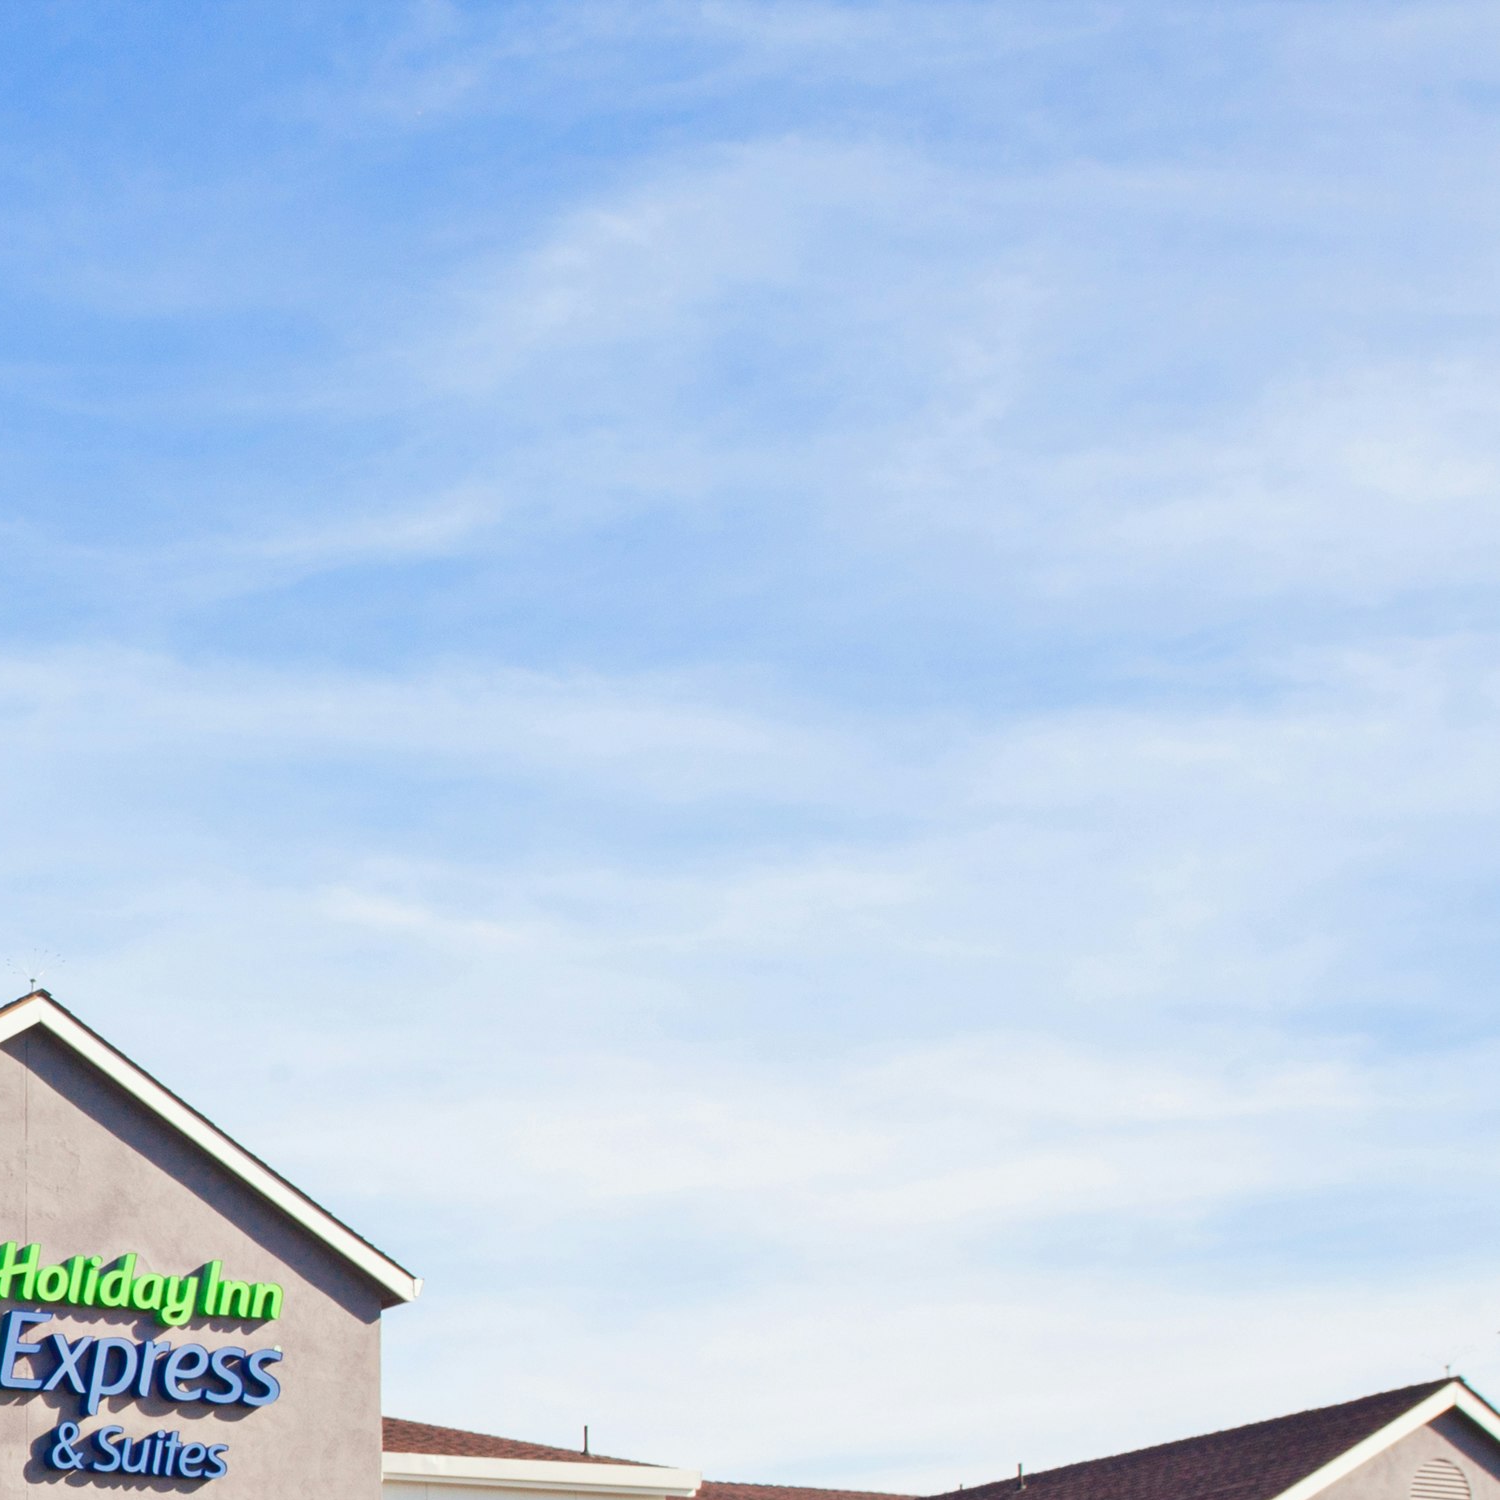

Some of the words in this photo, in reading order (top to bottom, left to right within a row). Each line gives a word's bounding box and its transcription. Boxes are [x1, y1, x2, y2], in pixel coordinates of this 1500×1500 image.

[203, 1259, 284, 1320] Inn
[50, 1421, 84, 1471] &
[93, 1424, 229, 1480] Suites
